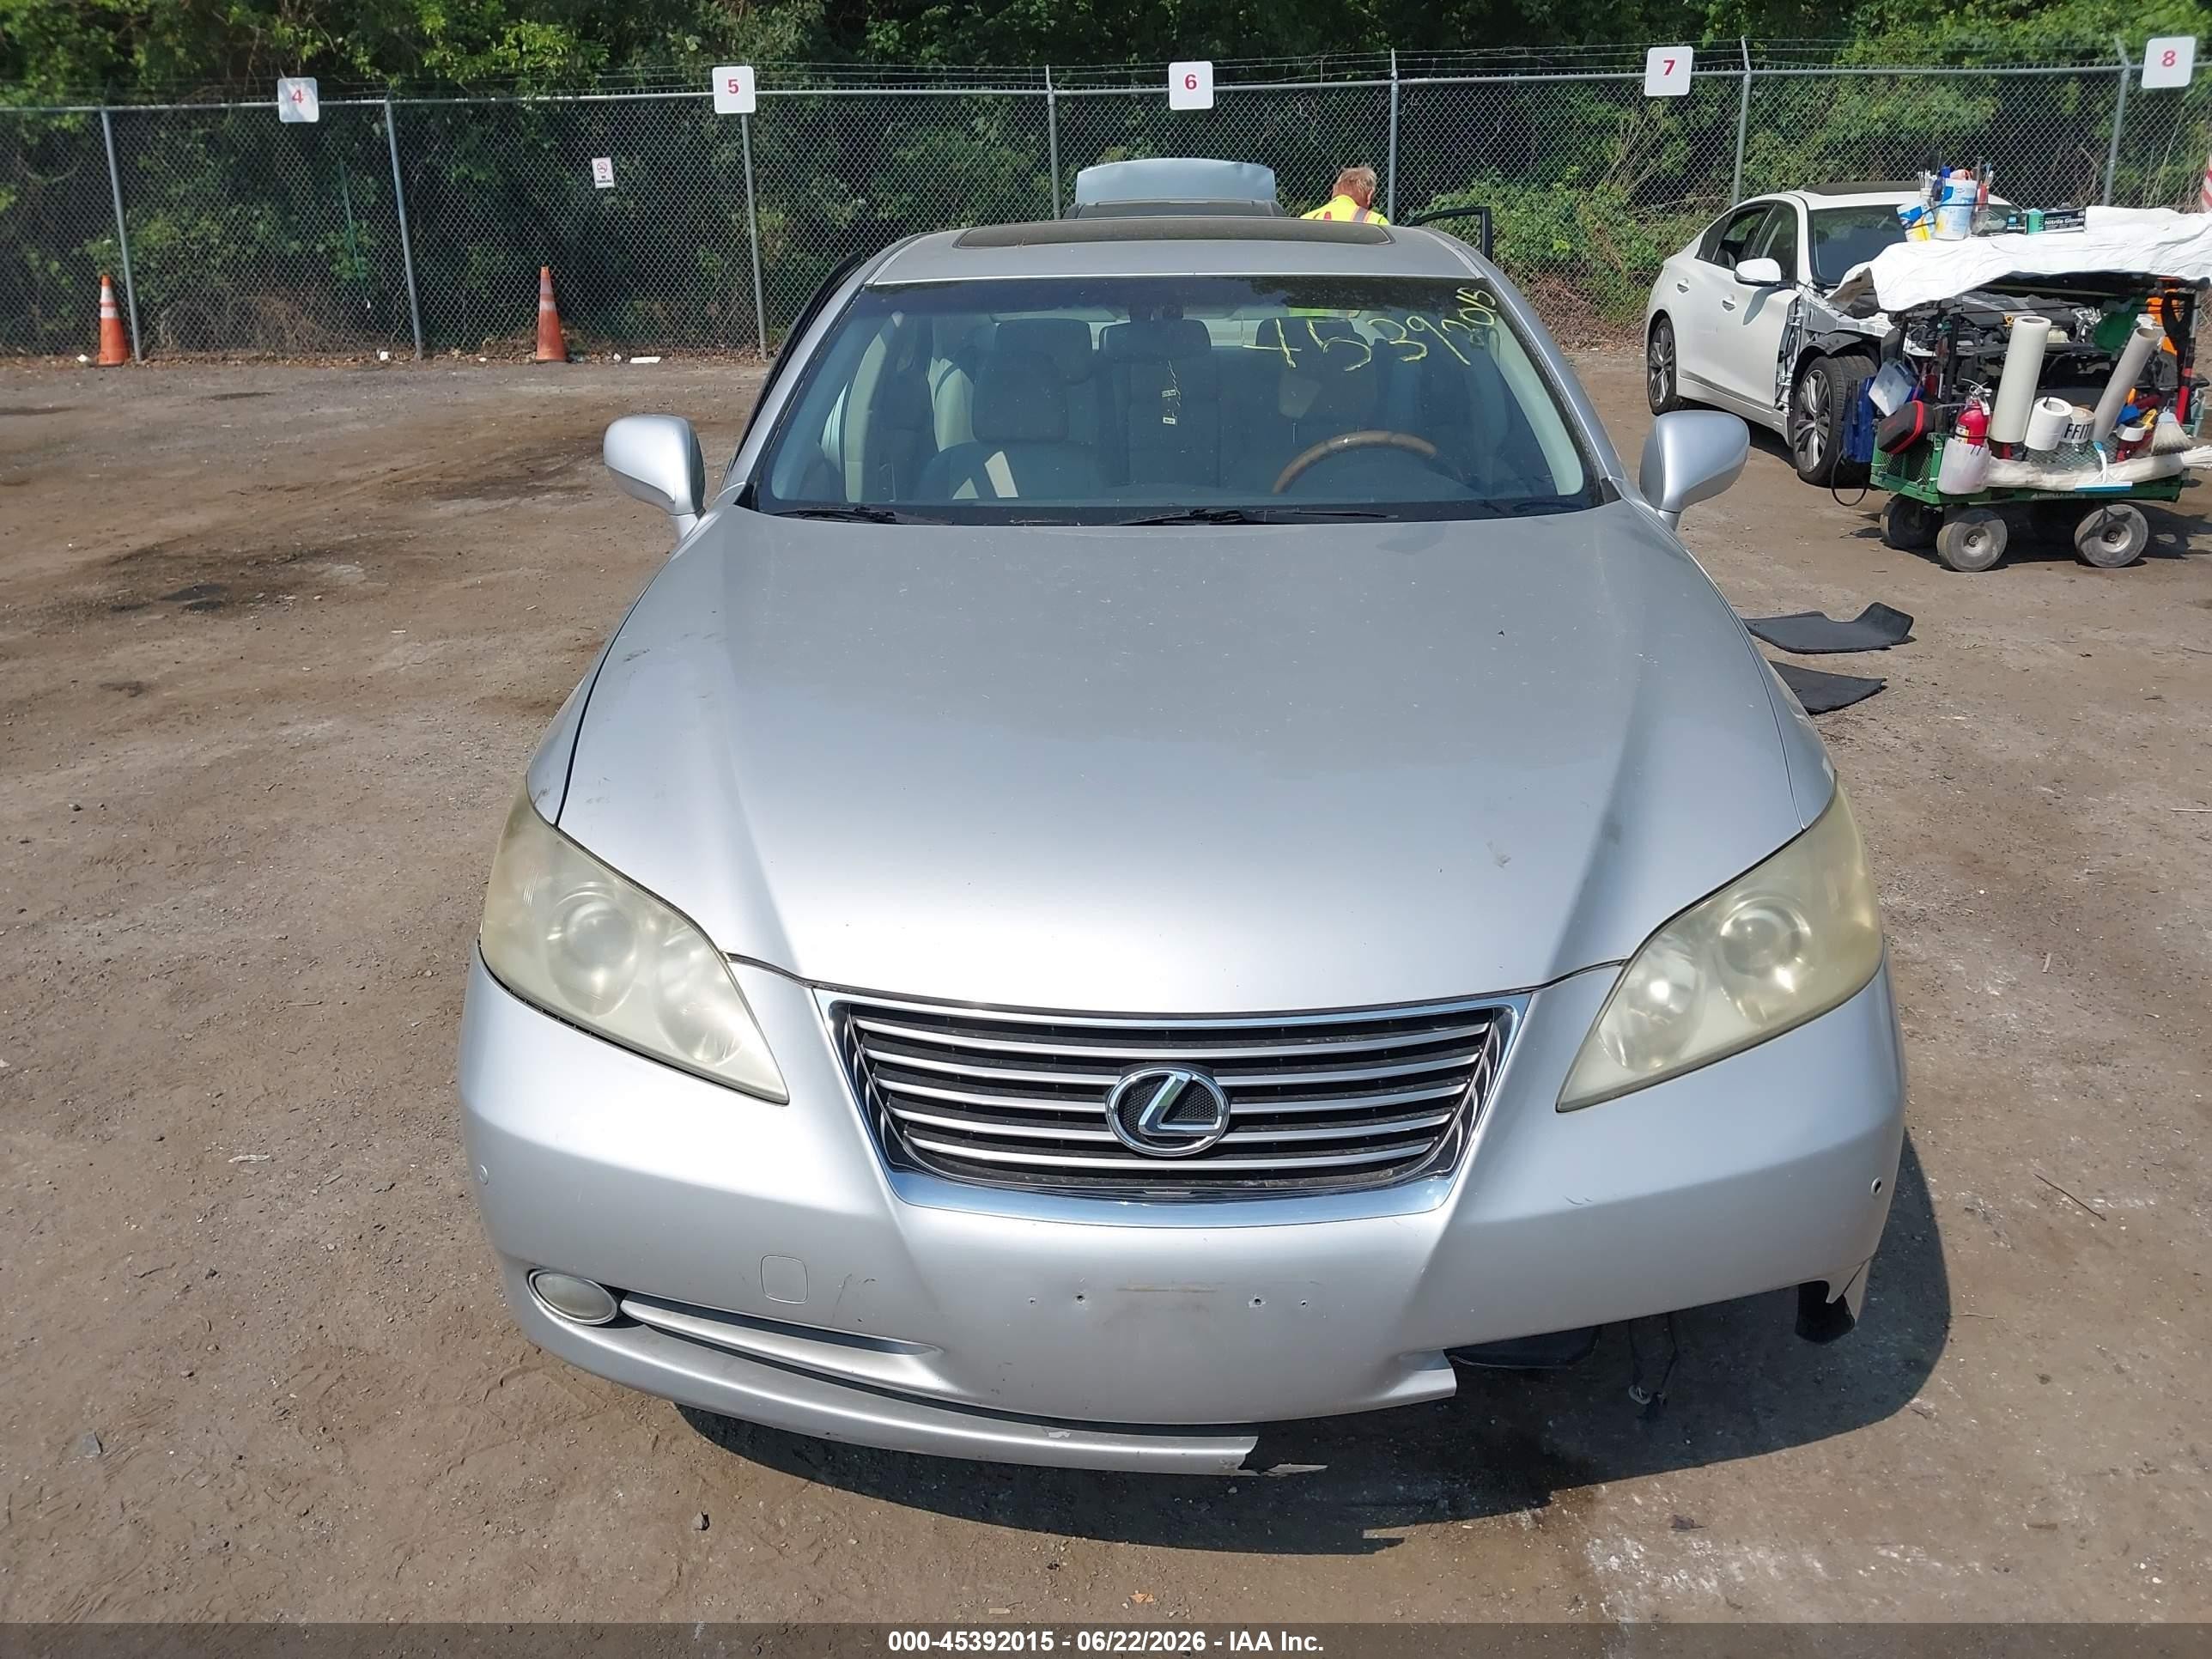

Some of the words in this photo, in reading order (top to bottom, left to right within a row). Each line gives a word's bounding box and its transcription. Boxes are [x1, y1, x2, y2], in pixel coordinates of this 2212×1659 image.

[2162, 50, 2176, 67] 8
[1663, 59, 1675, 76] 7
[728, 78, 739, 94] 5
[1185, 74, 1197, 90] 6
[292, 89, 304, 104] 4
